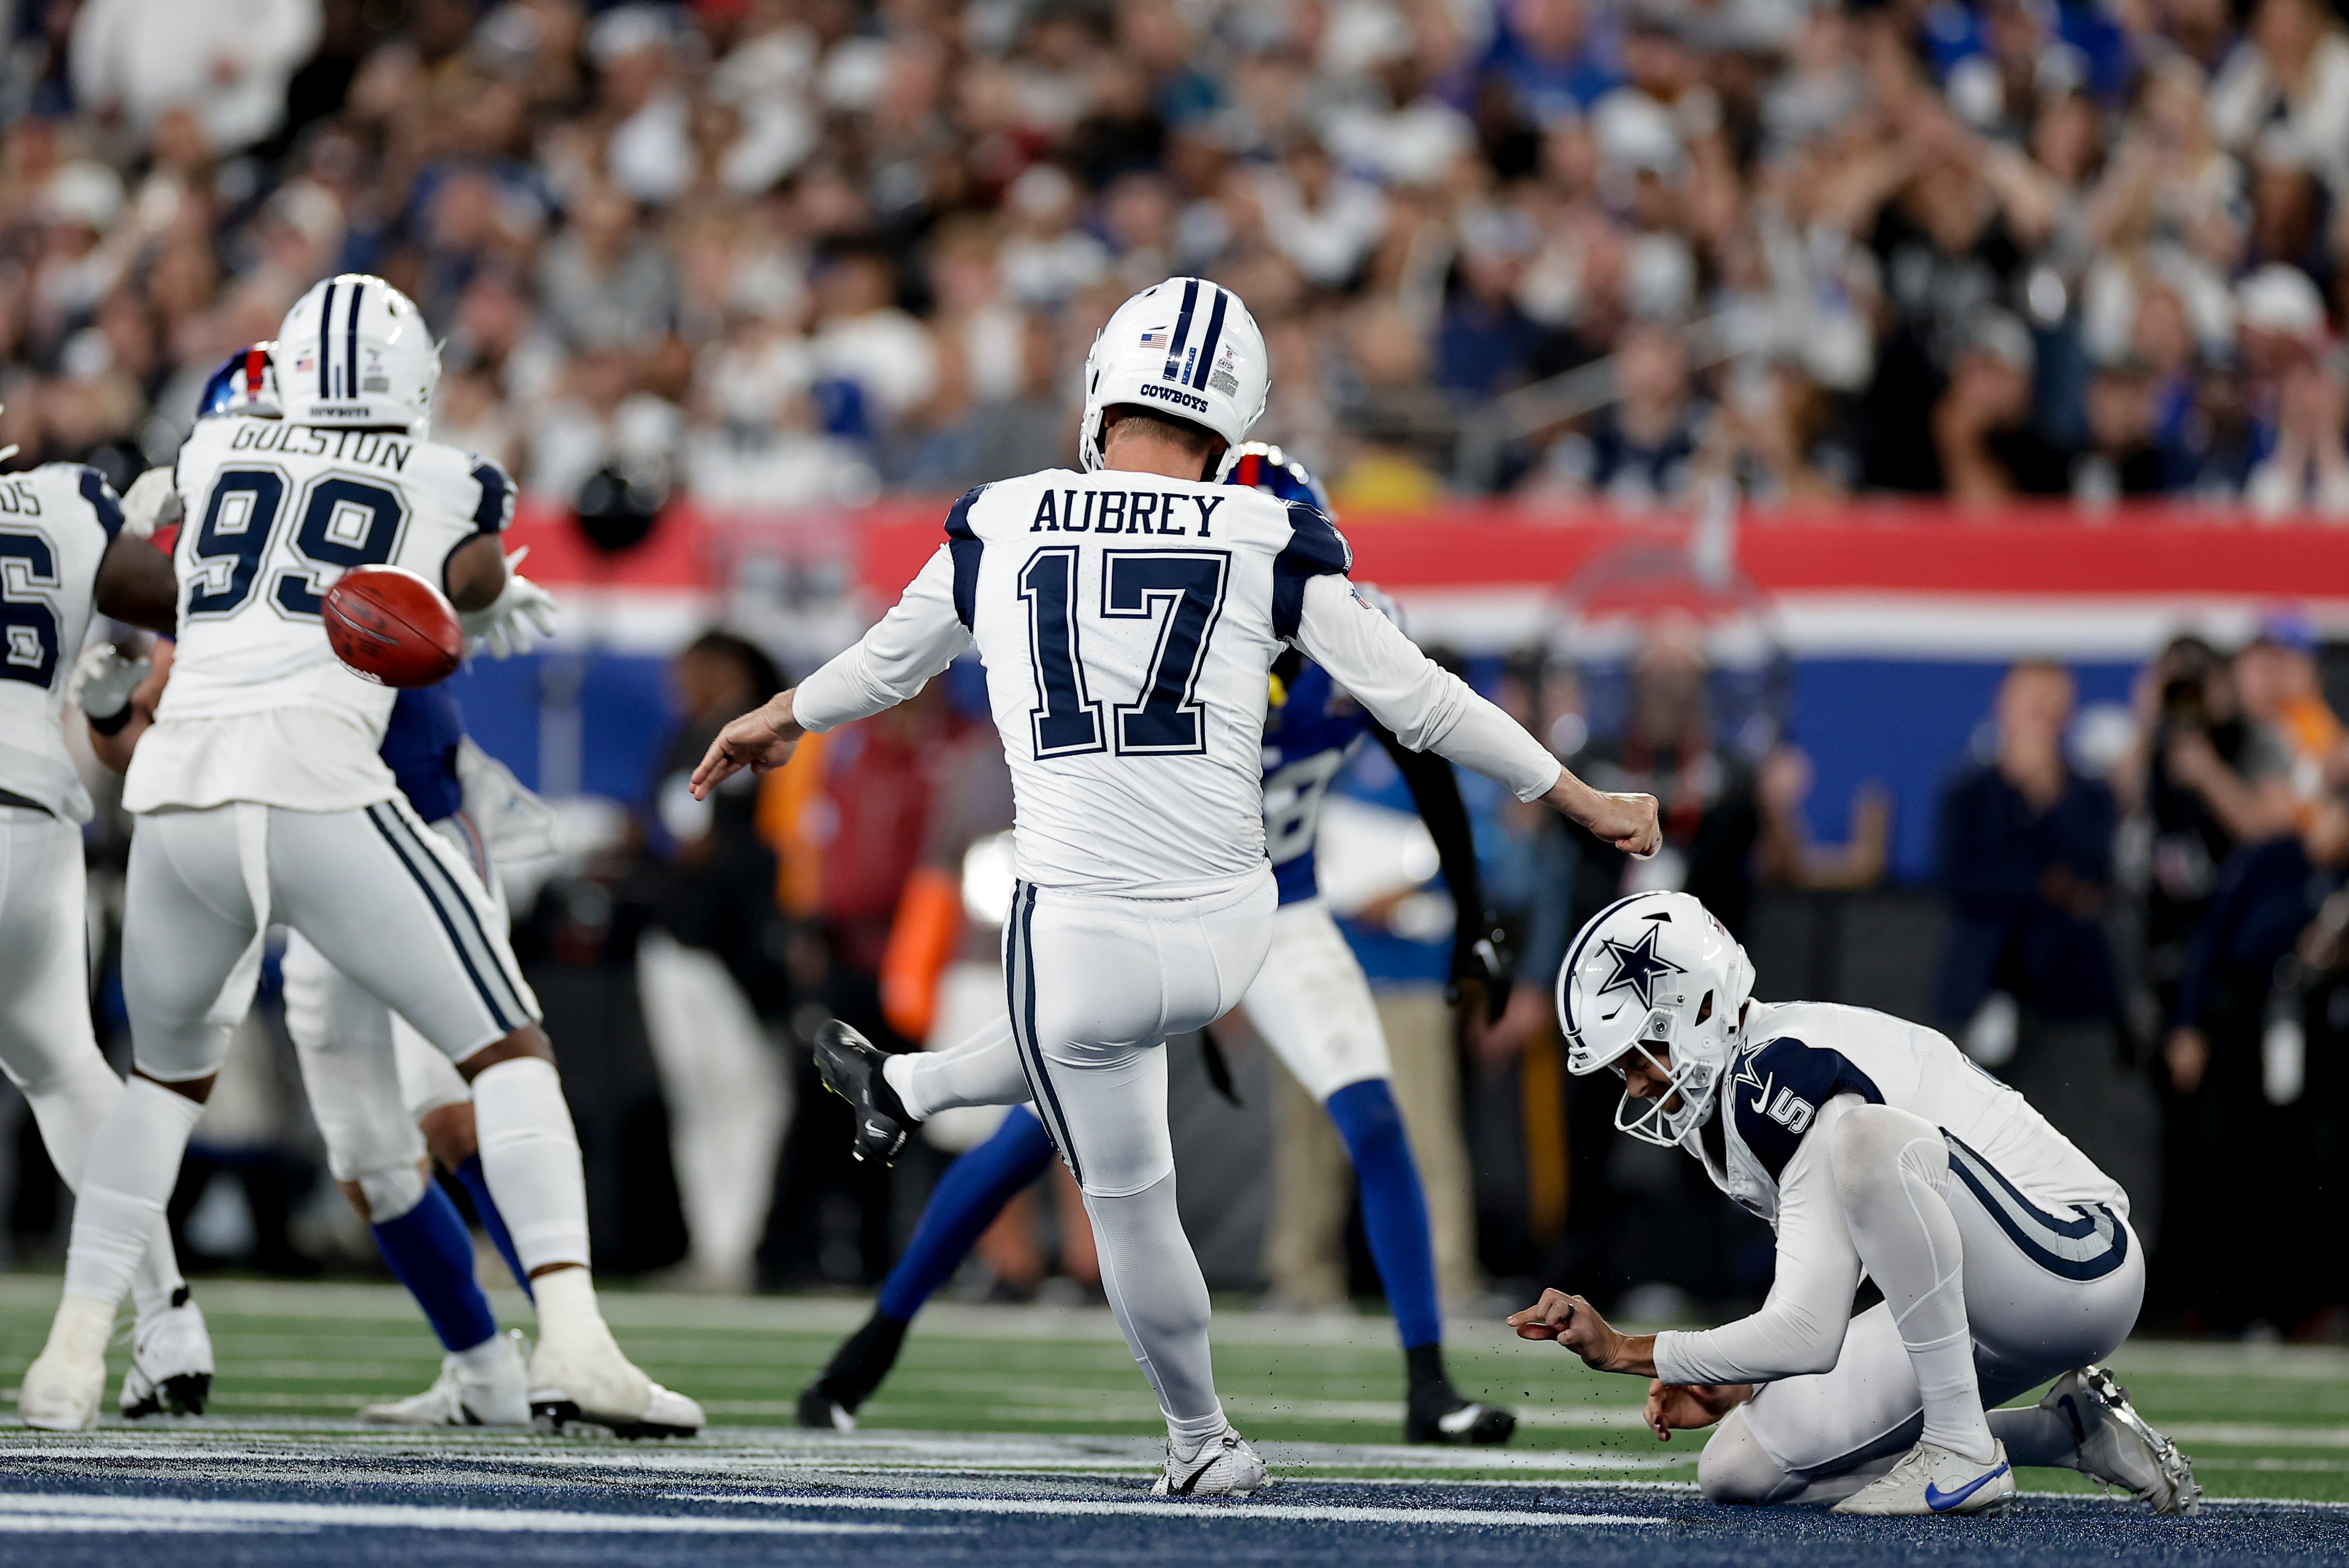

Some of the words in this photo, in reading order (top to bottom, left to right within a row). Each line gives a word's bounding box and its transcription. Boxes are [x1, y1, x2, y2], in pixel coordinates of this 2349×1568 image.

[1218, 359, 1234, 371] CATCH
[1140, 384, 1208, 413] COWBOYS
[1030, 489, 1224, 538] AUBREY
[184, 462, 411, 623] 99
[1017, 545, 1232, 761] 17
[1766, 1086, 1814, 1134] 5
